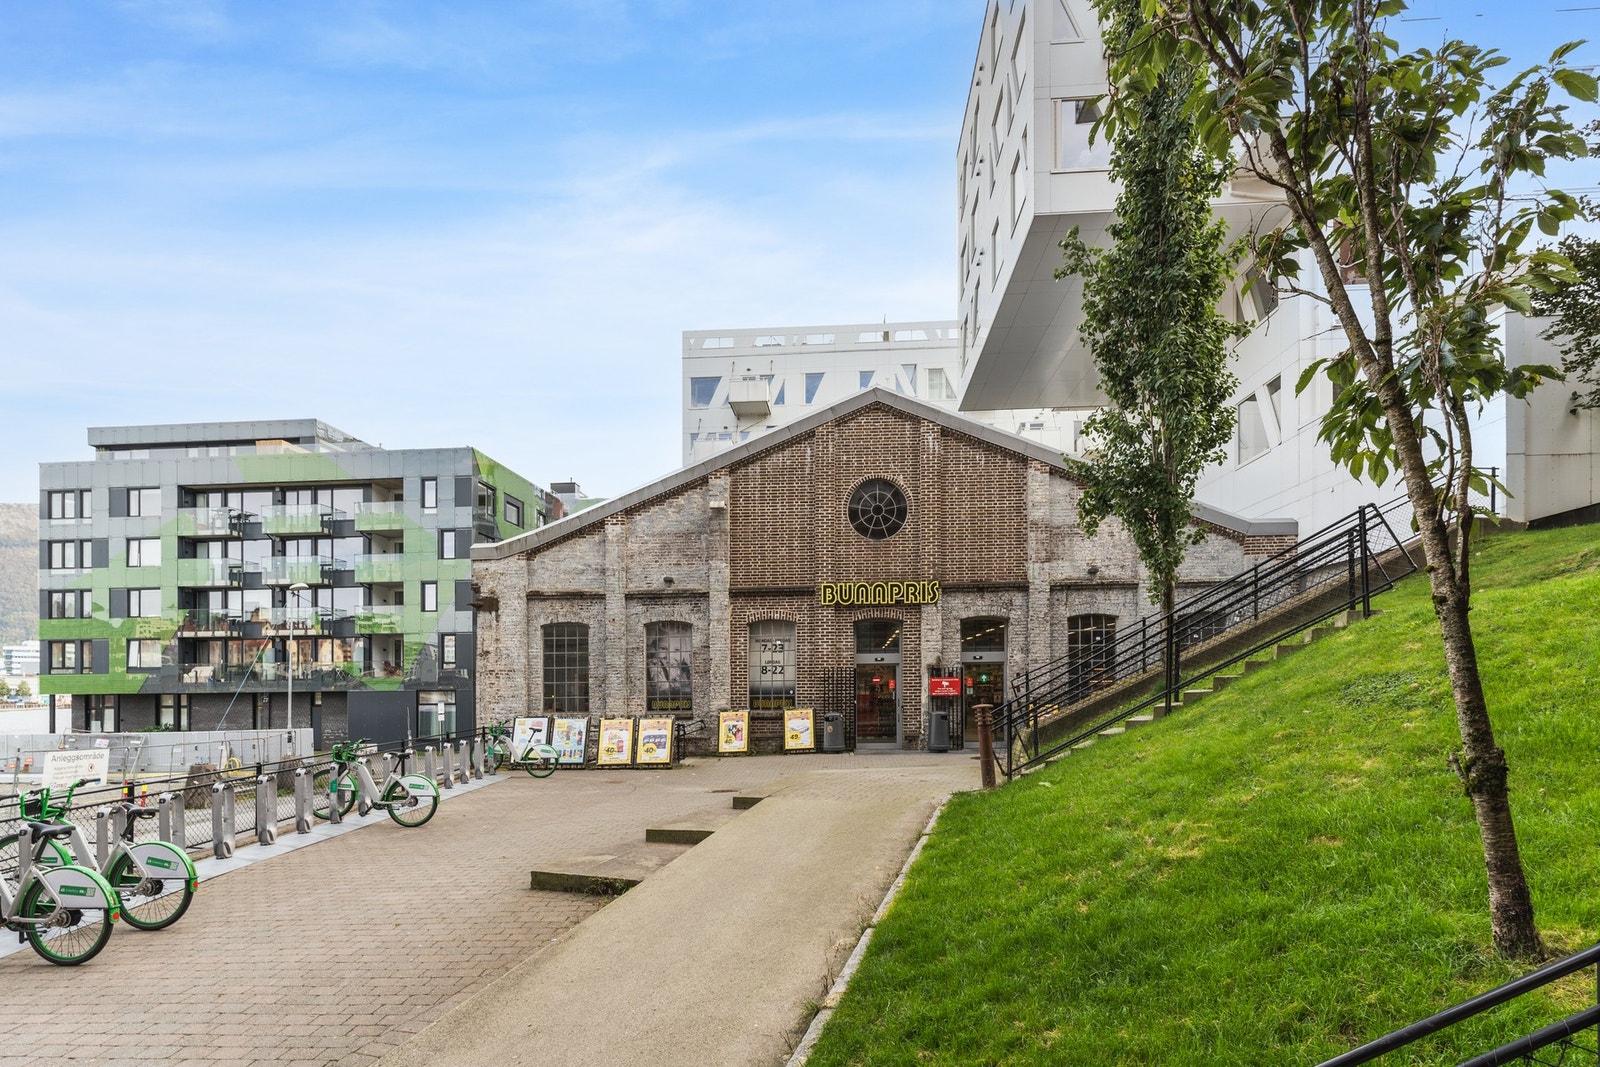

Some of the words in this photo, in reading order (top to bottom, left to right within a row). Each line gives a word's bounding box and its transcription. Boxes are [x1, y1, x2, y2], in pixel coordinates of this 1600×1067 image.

[821, 581, 940, 605] BUNNPRIS
[761, 643, 784, 653] 7-23
[761, 665, 784, 675] 8-22
[50, 751, 105, 763] Anleggsområde
